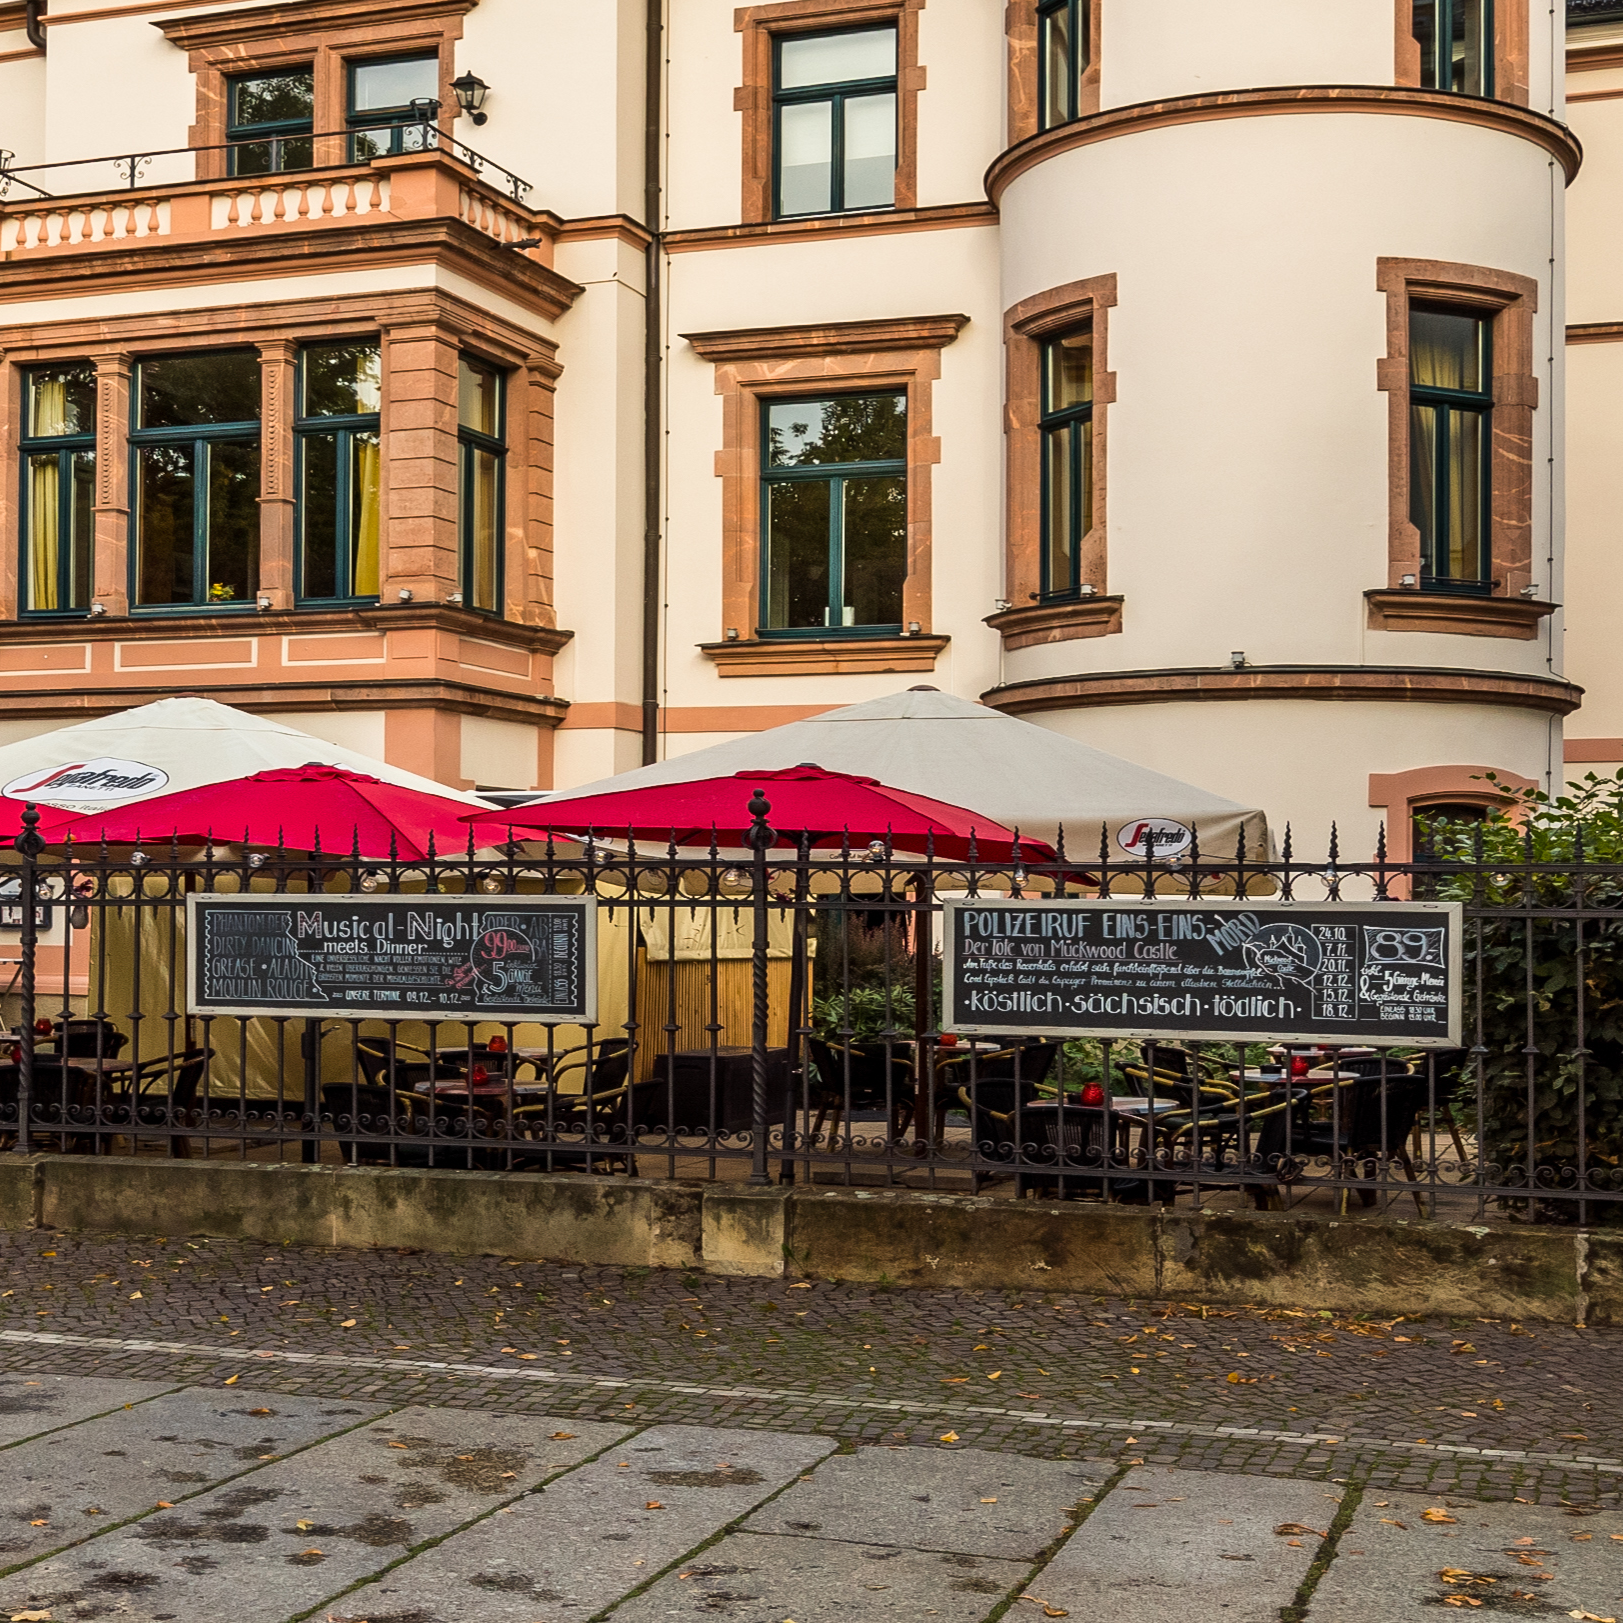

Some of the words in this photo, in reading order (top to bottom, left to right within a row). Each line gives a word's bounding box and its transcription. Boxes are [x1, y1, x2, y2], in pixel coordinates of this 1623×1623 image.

[9, 764, 156, 794] Segafredo
[213, 913, 265, 933] PHANTOM
[297, 911, 480, 948] Musical-Night
[963, 911, 1092, 937] POLIZEIRUF
[1206, 912, 1260, 956] MORD
[1318, 926, 1347, 941] 24.10.
[213, 936, 250, 955] DIRTY
[323, 939, 368, 954] meets
[377, 939, 428, 955] Dinner
[963, 939, 988, 955] Der
[1021, 943, 1045, 957] von
[1134, 941, 1179, 959] Castle
[1325, 943, 1349, 957] 7.11.
[211, 957, 258, 978] GREASE
[442, 966, 452, 975] DIE
[998, 959, 1013, 970] des
[1091, 962, 1112, 973] sich
[1183, 964, 1200, 975] über
[1202, 965, 1215, 975] die
[1321, 959, 1350, 972] 20.11.
[373, 974, 385, 983] DER
[489, 962, 508, 992] 5
[1135, 979, 1148, 987] zu
[1322, 974, 1352, 987] 12.12.
[1382, 970, 1393, 992] 5
[211, 978, 261, 998] MOULIN
[266, 978, 310, 999] ROUGE
[345, 989, 371, 1001] UNSERE
[372, 990, 401, 1001] TERMINE
[481, 984, 492, 994] &
[1322, 989, 1353, 1002] 15.12.
[1359, 975, 1371, 1001] &
[971, 990, 1063, 1012] köstlich
[1071, 992, 1201, 1016] sächsisch
[1212, 994, 1295, 1018] tödlich
[1322, 1004, 1353, 1018] 18.12.
